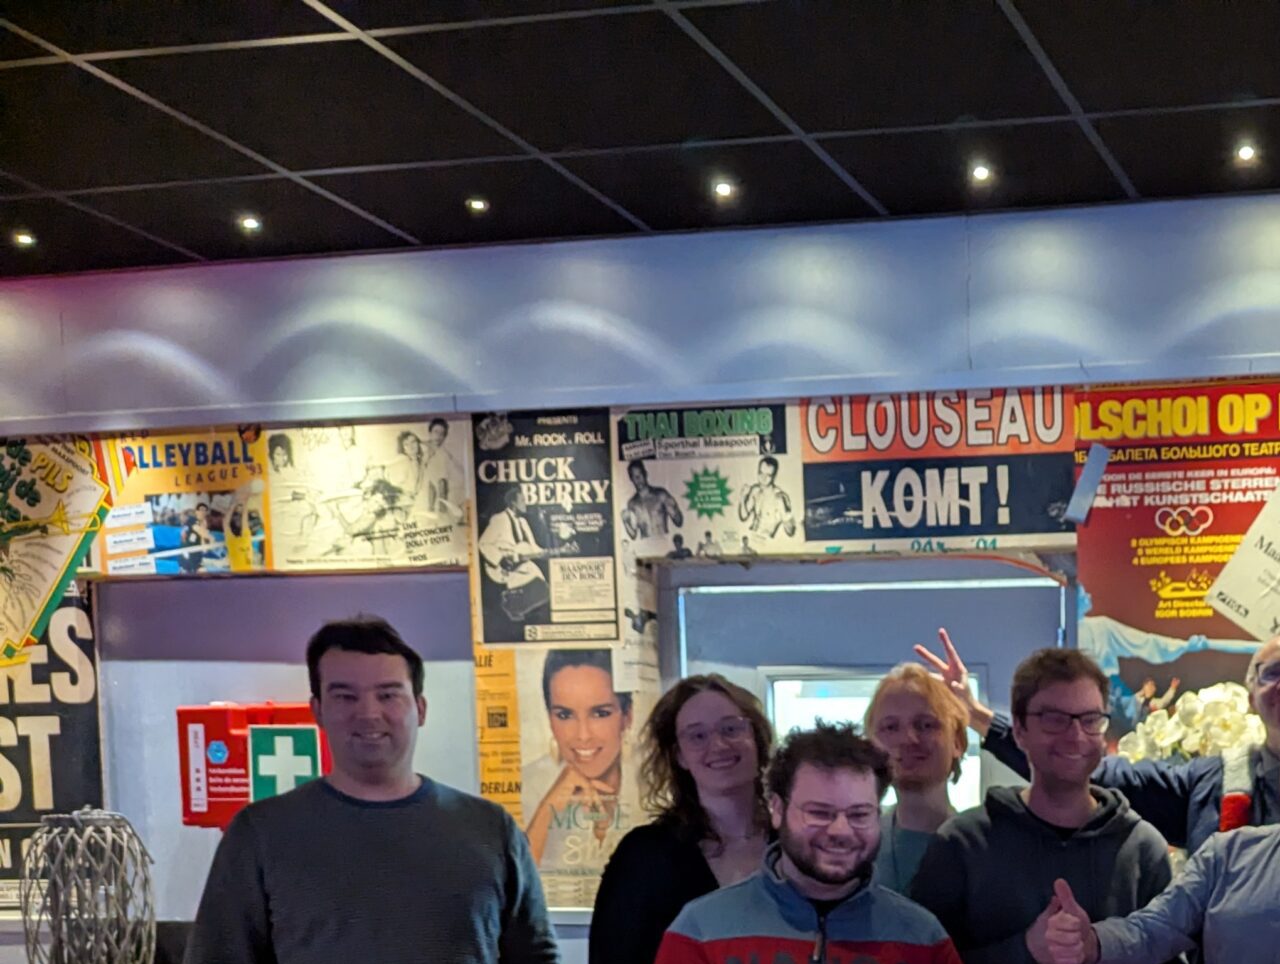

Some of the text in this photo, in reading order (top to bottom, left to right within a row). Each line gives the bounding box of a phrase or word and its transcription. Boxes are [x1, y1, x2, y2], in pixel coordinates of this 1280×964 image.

[625, 407, 773, 441] THAI BOXING
[806, 384, 1065, 453] CLOUSEAU
[1217, 394, 1271, 435] OP
[533, 433, 567, 446] ROCK
[574, 431, 605, 445] ROLL
[703, 436, 757, 449] Maaspoort
[1161, 446, 1241, 461] БОЛЬШОГО
[174, 466, 239, 487] LEAGUE
[478, 456, 576, 483] CHUCK
[521, 479, 609, 505] BERRY
[861, 465, 1010, 528] KOMT!
[1111, 480, 1207, 494] RUSSISCHE
[1144, 490, 1272, 506] KUNSTSCHAATS
